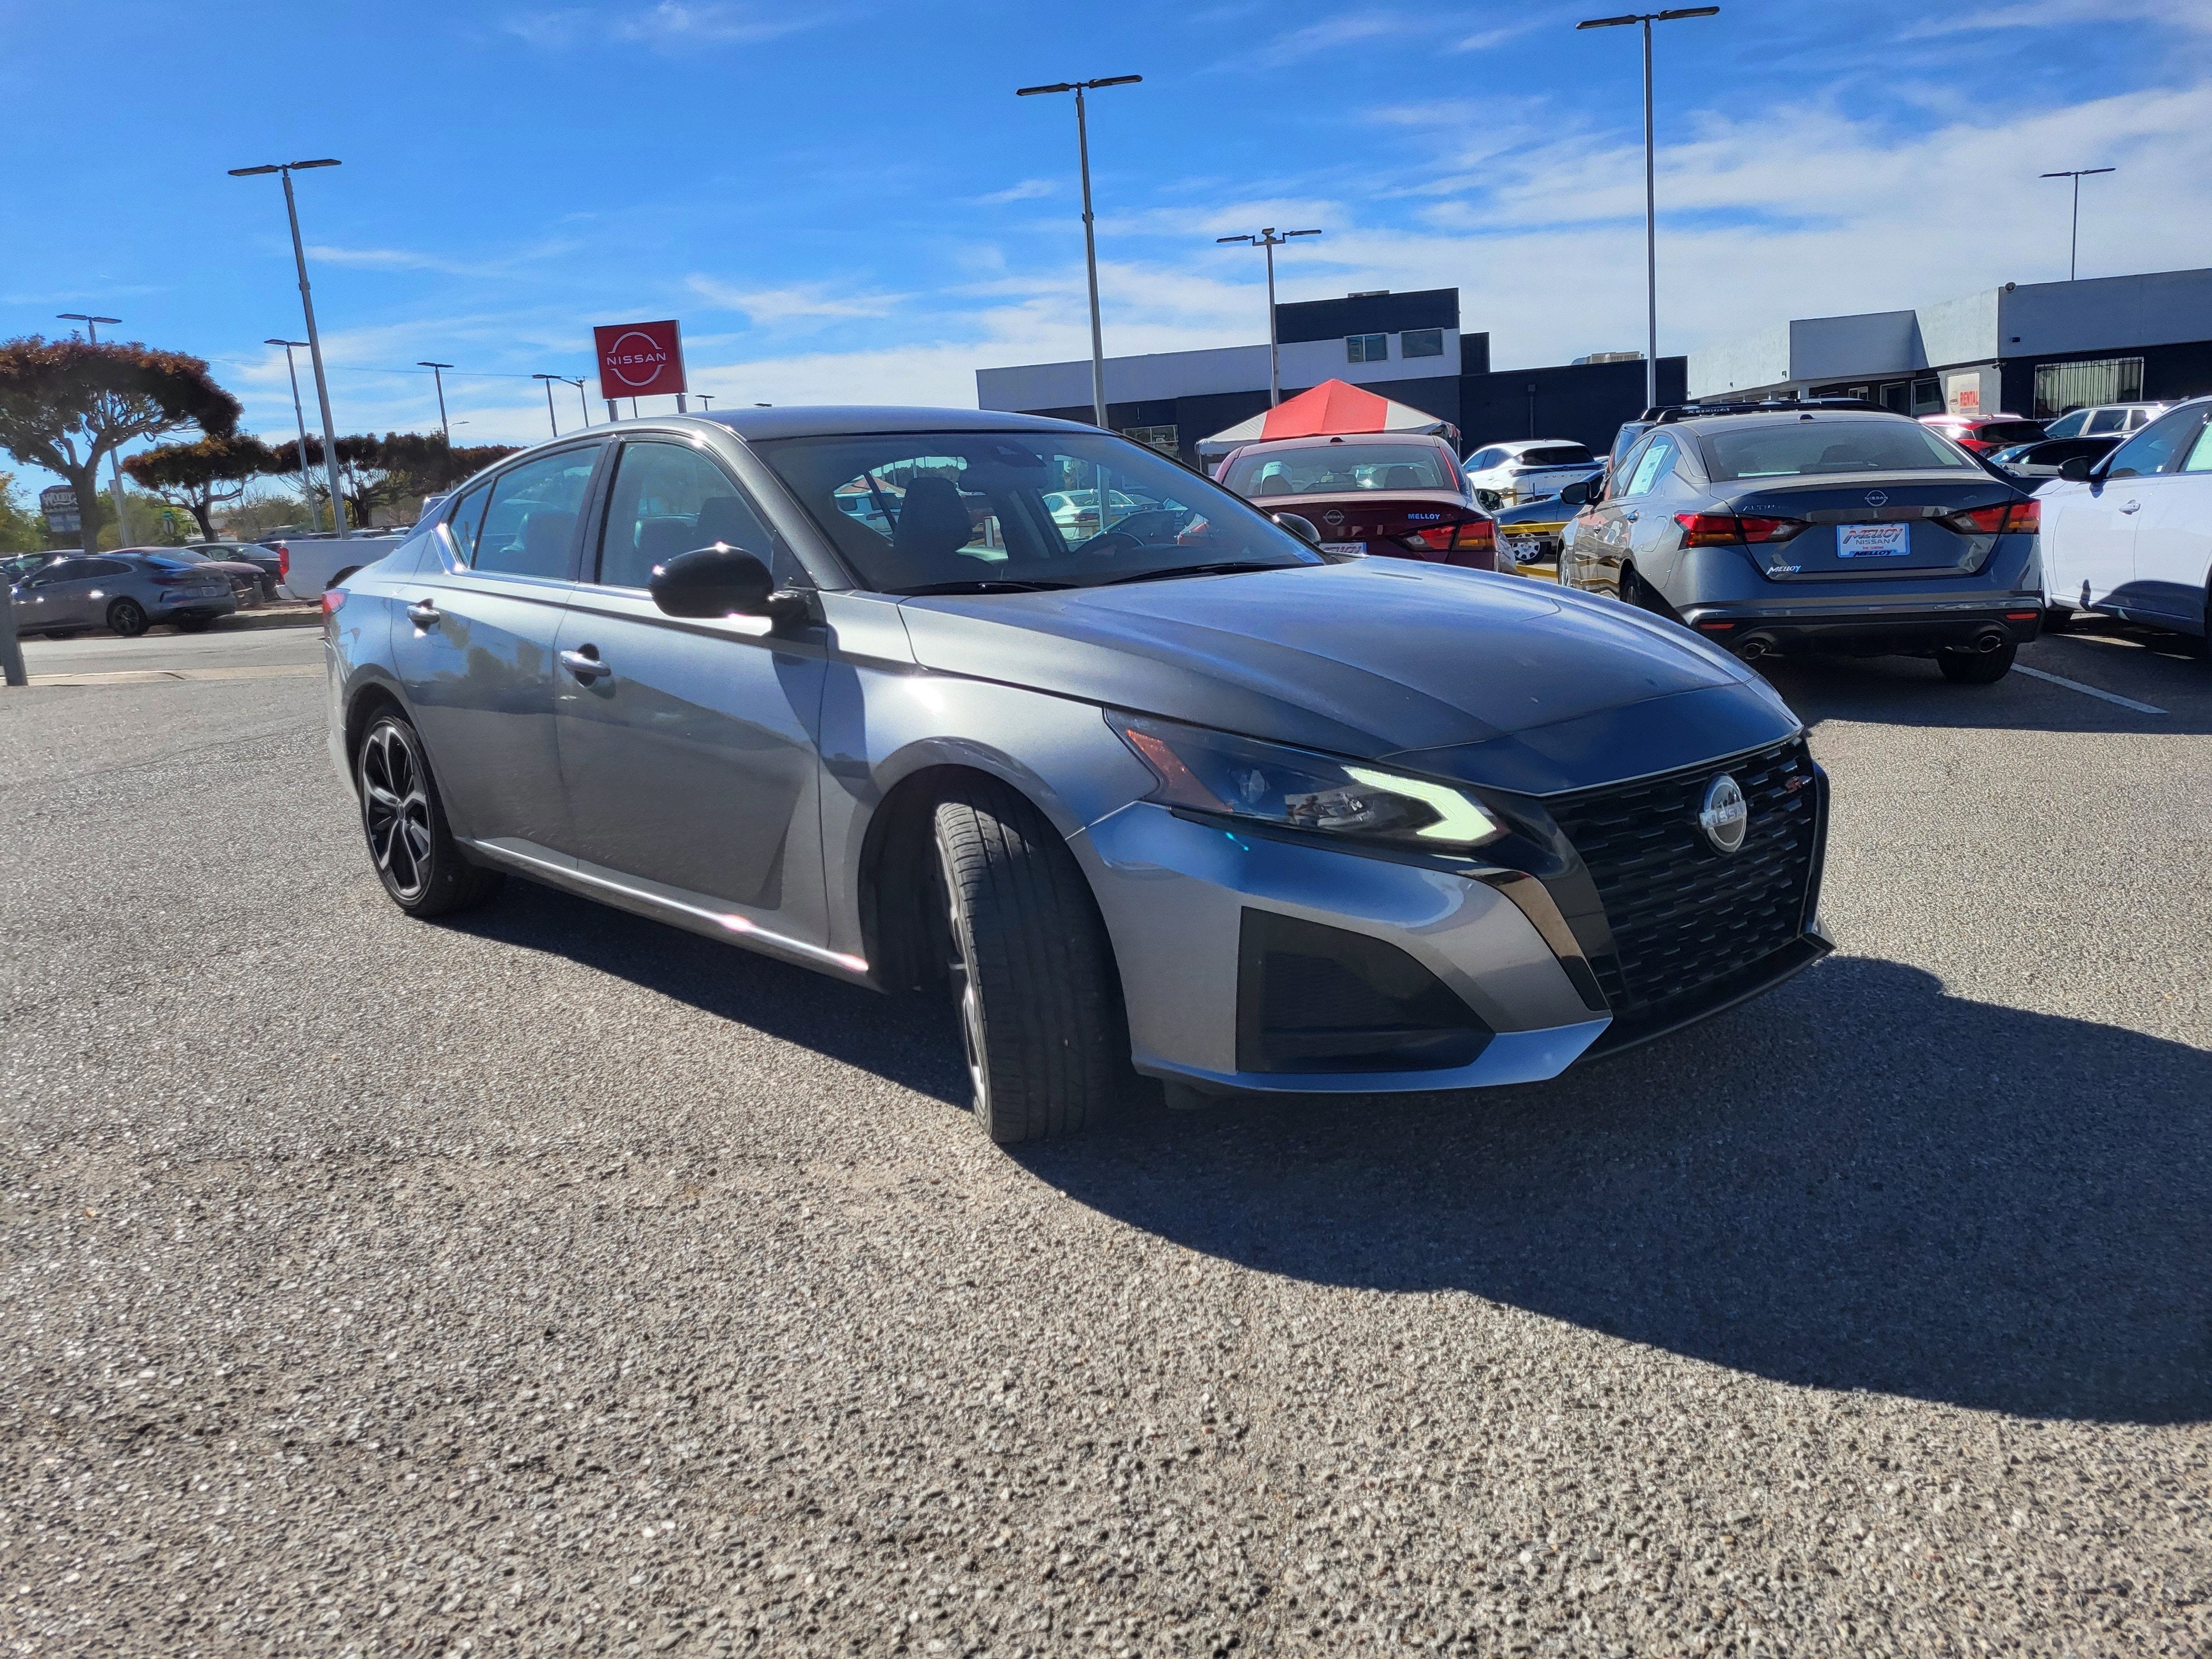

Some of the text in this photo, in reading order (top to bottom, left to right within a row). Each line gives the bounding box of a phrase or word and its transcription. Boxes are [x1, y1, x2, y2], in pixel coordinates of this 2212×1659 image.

[607, 352, 666, 366] NISSAN
[1960, 391, 1978, 406] RENTAL
[1843, 528, 1903, 544] MELLOY
[1766, 565, 1802, 575] MELLOY
